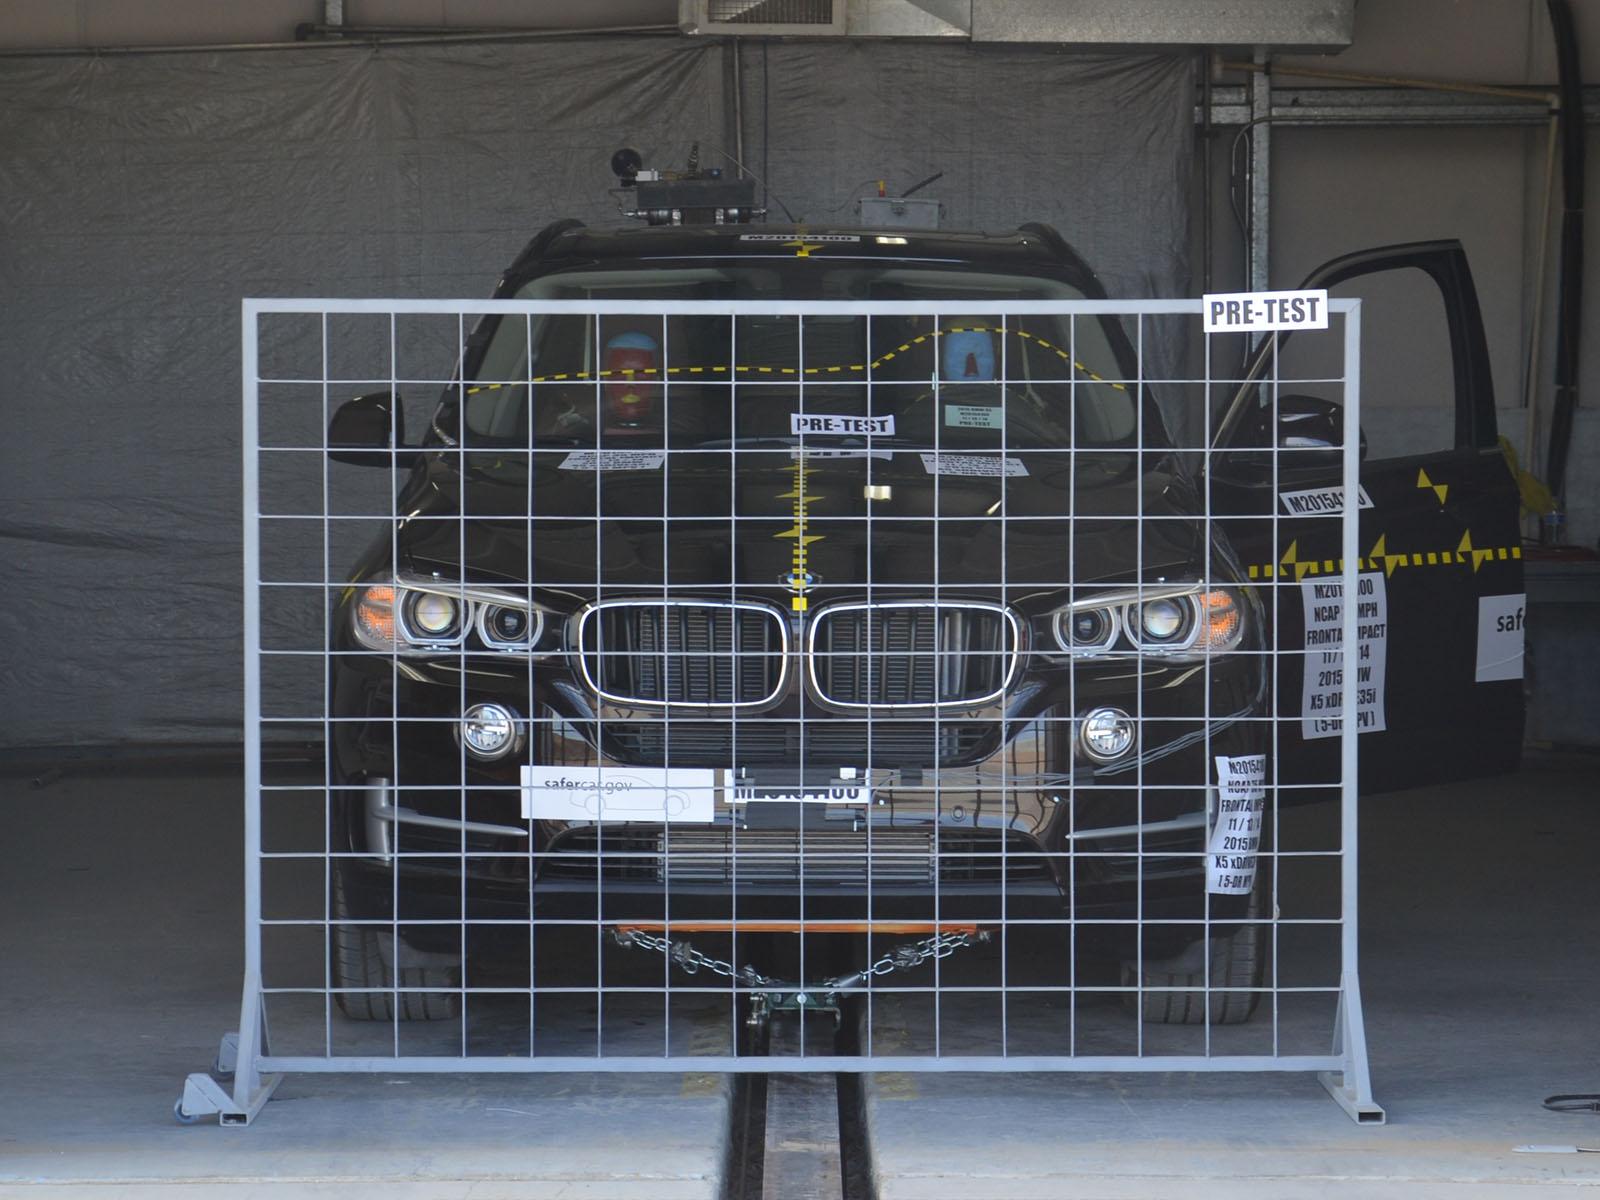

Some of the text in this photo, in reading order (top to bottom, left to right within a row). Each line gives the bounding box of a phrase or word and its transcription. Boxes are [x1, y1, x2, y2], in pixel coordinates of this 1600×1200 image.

[1211, 298, 1320, 325] PRE-TEST
[797, 418, 888, 432] PRE-TEST
[1314, 605, 1340, 622] NCAP
[1360, 645, 1369, 660] 14
[1318, 669, 1343, 687] 2015
[1310, 694, 1323, 710] X5
[1223, 836, 1248, 850] 2015
[1215, 856, 1228, 869] X5
